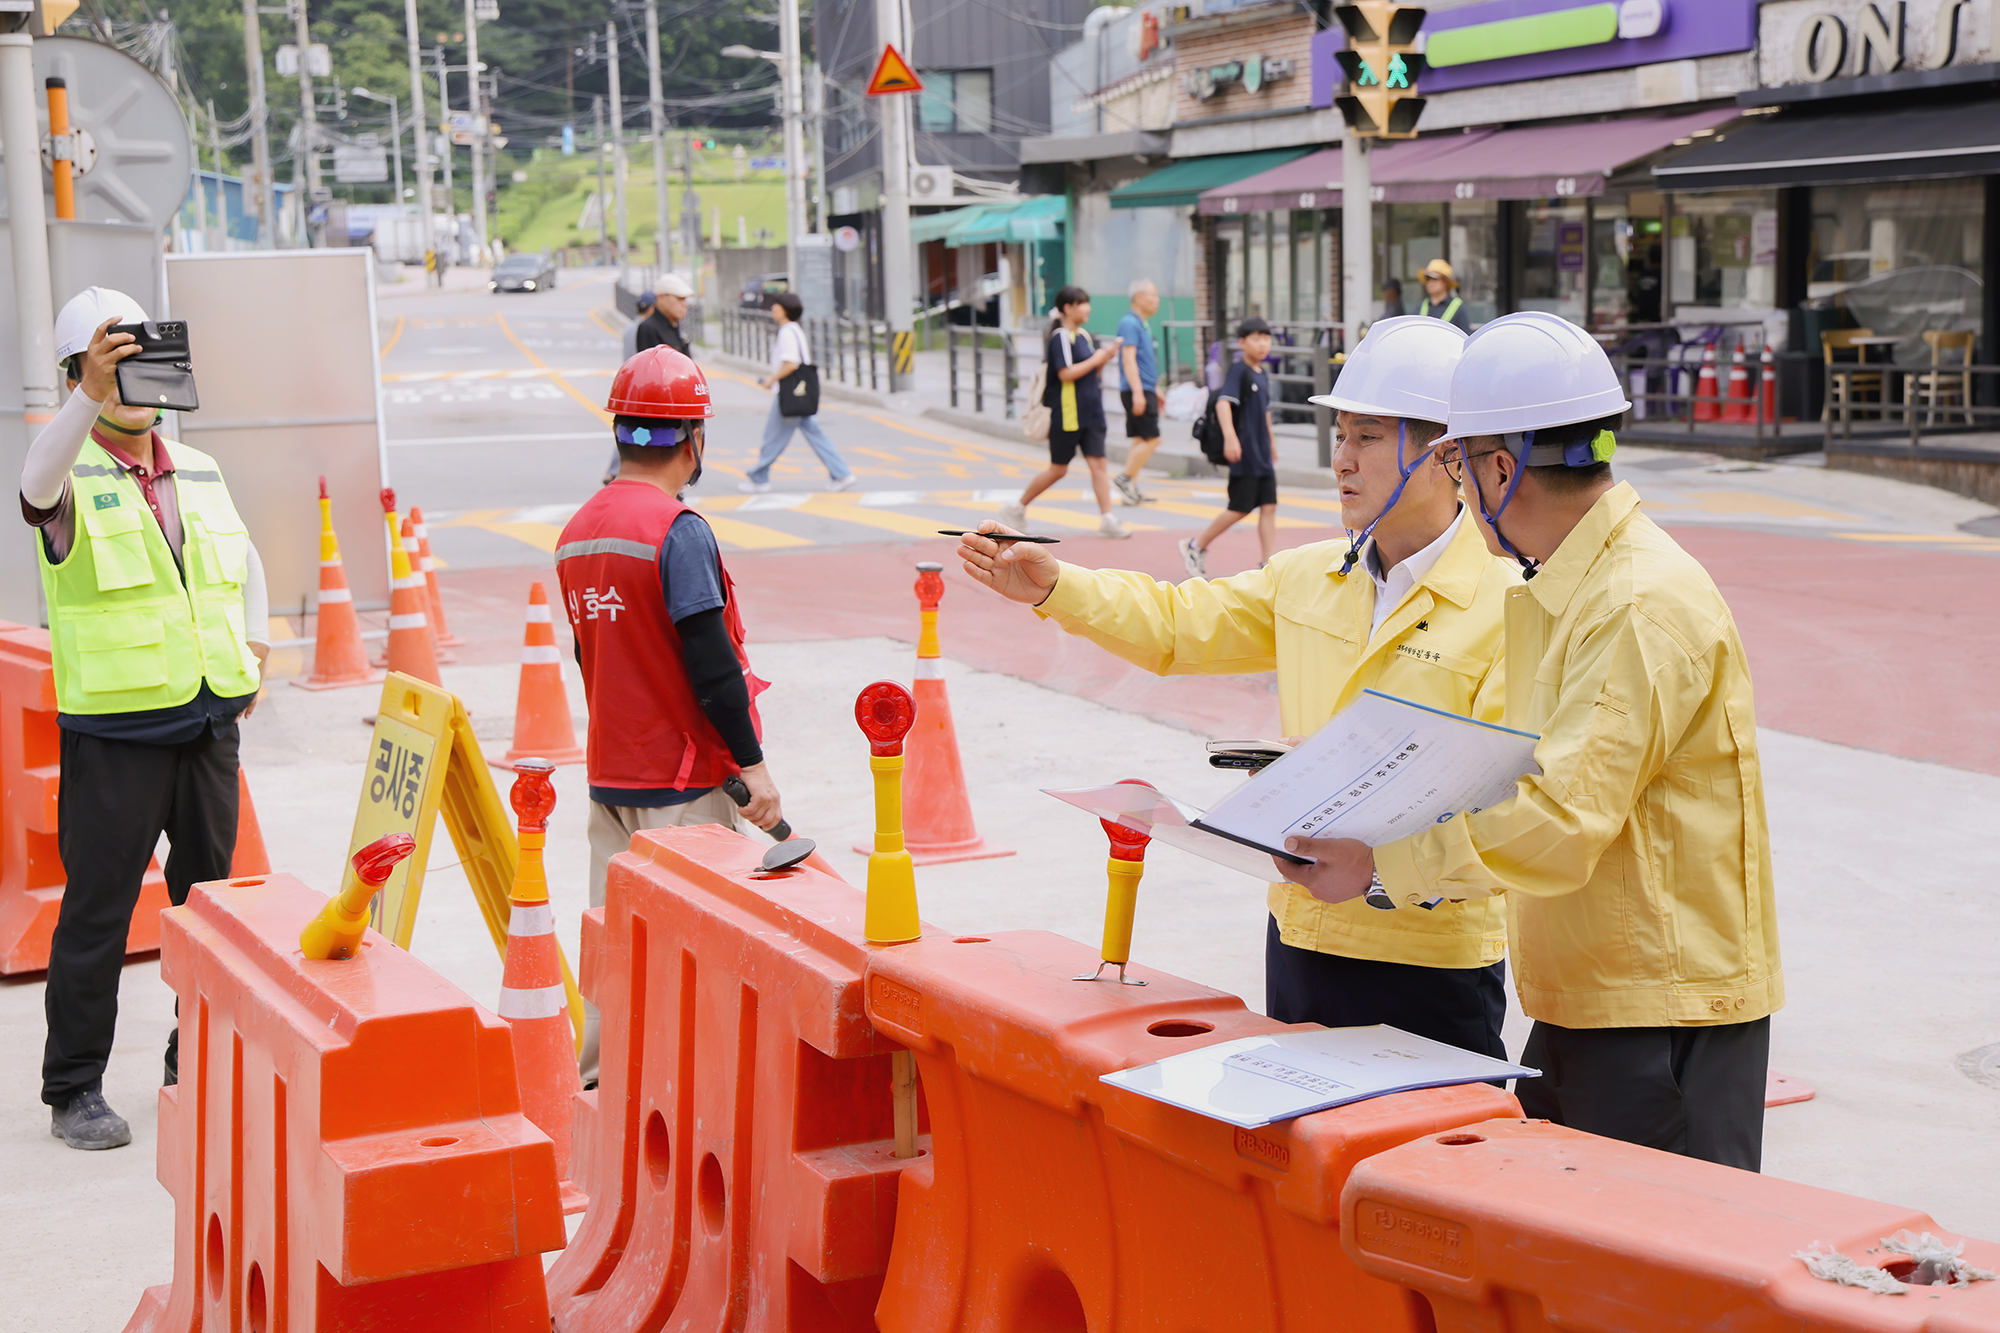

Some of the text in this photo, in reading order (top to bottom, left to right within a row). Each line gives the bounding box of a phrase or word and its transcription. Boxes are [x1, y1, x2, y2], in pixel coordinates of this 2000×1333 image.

[1556, 177, 1576, 195] CU
[567, 586, 626, 625] 신호수
[370, 738, 425, 820] 공사중
[1301, 800, 1347, 830] 하수관로
[1348, 781, 1373, 797] 정비
[1239, 1131, 1290, 1165] RB-3000
